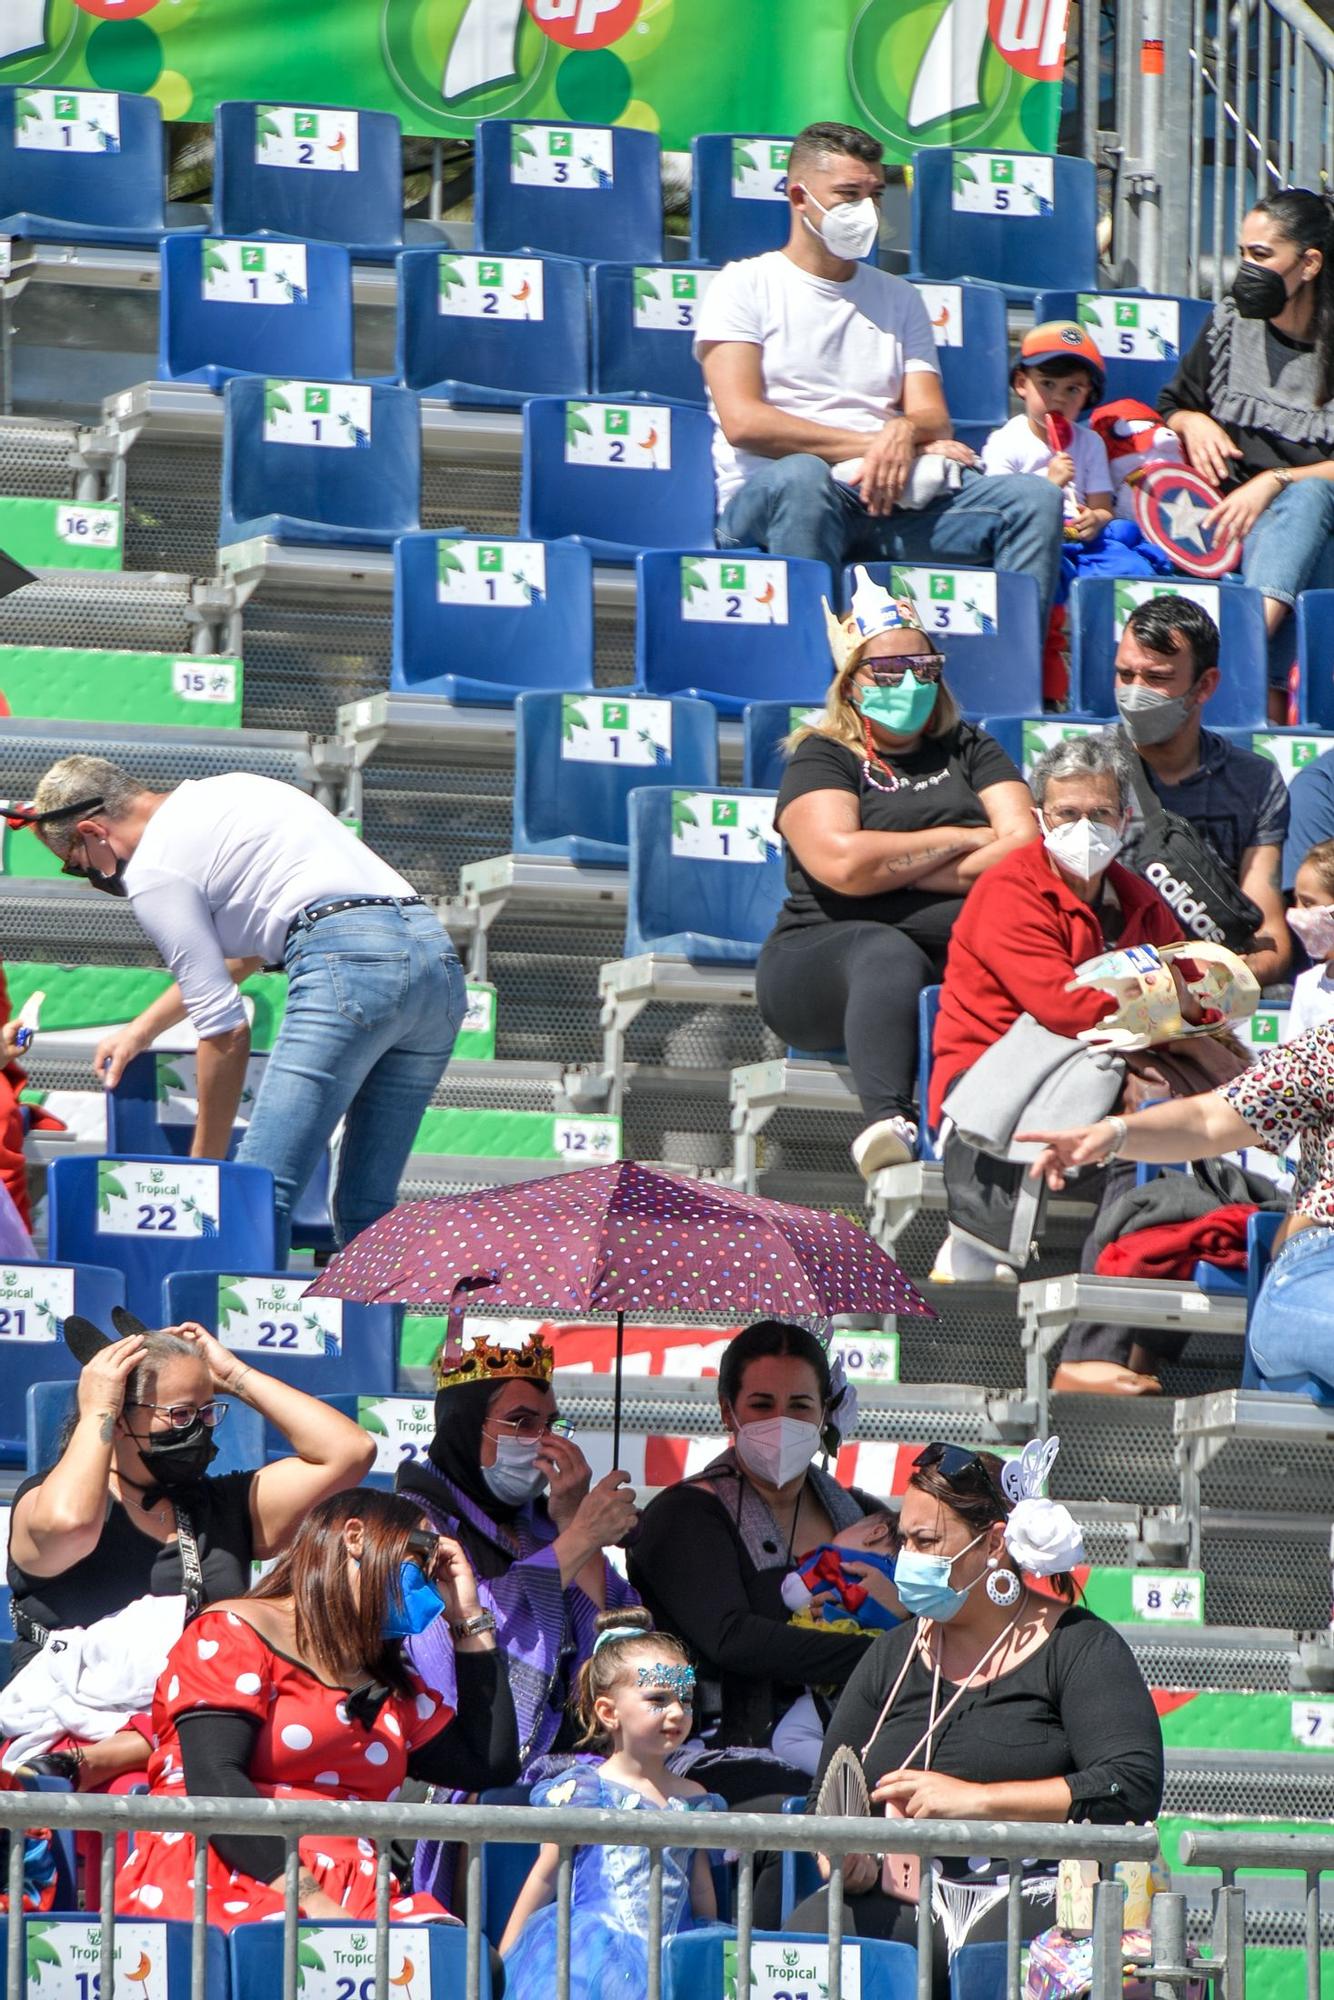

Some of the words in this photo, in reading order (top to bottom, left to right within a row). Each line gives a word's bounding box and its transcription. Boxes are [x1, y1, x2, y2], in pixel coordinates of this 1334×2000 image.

[61, 126, 72, 147] 1
[298, 143, 314, 165] 2
[553, 162, 568, 184] 3
[995, 189, 1010, 211] 5
[248, 278, 258, 299] 1
[482, 292, 498, 314] 2
[677, 304, 693, 326] 3
[1119, 333, 1134, 354] 5
[311, 419, 321, 441] 1
[609, 441, 624, 463] 2
[66, 517, 88, 535] 16
[485, 579, 495, 601] 1
[726, 596, 742, 618] 2
[935, 606, 950, 628] 3
[183, 673, 205, 691] 15
[609, 736, 619, 758] 1
[719, 833, 729, 856] 1
[1145, 862, 1226, 944] adidas
[563, 1131, 586, 1150] 12
[135, 1181, 180, 1197] Tropical
[137, 1204, 177, 1231] 22
[256, 1297, 302, 1313] Tropical
[257, 1321, 299, 1349] 22
[837, 1350, 863, 1369] 10
[1147, 1589, 1161, 1608] 8
[1307, 1714, 1322, 1736] 7
[333, 1950, 377, 1967] Tropic
[766, 1964, 817, 1981] Tropical
